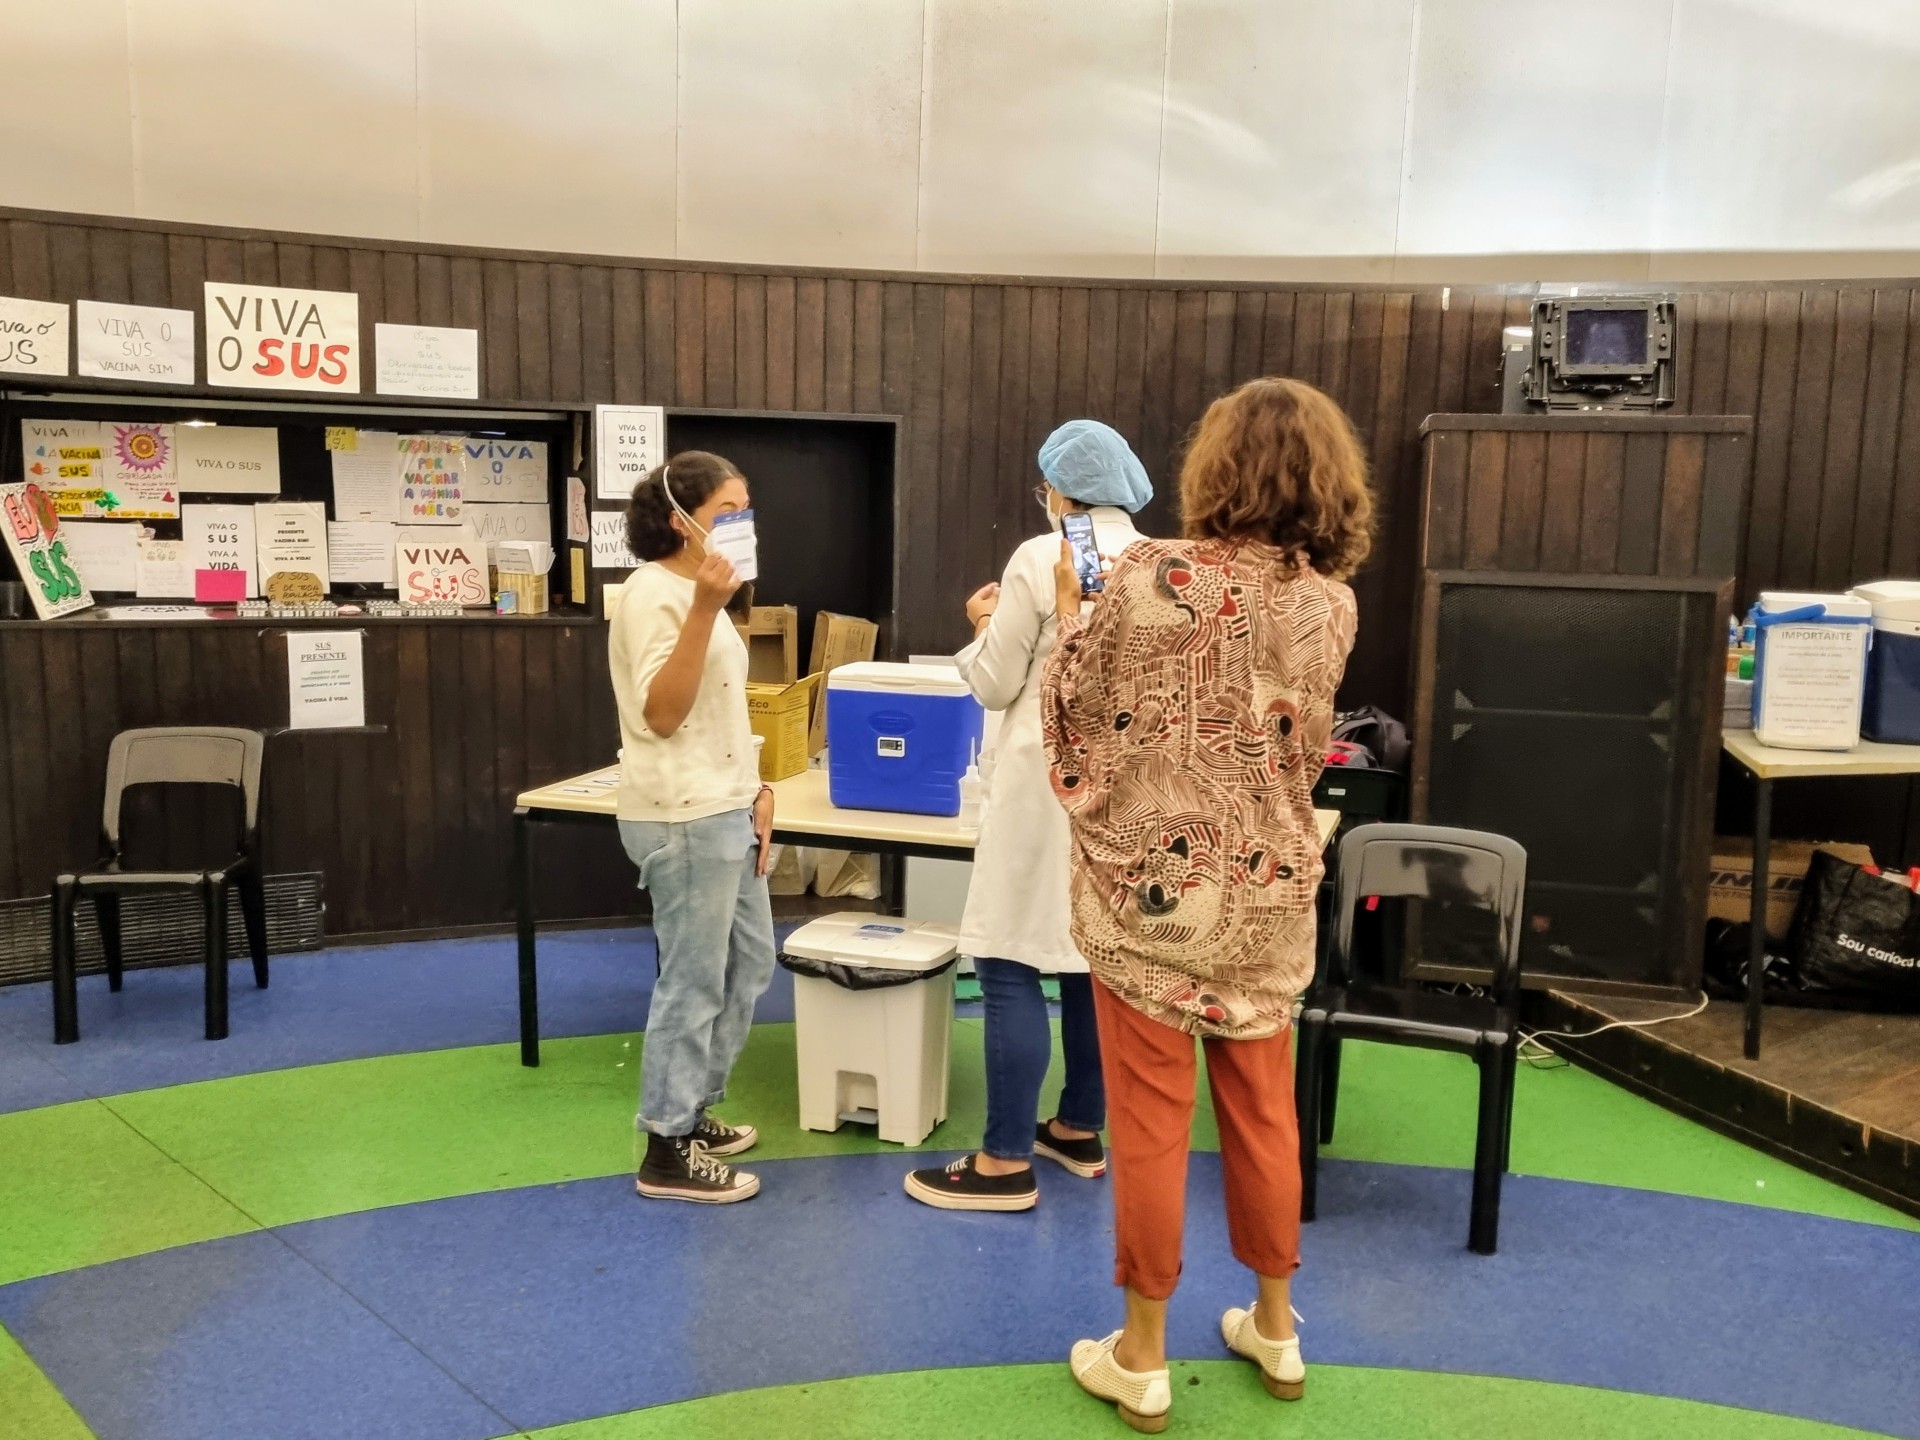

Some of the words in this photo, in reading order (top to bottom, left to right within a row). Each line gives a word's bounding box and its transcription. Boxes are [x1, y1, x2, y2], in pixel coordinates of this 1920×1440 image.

[215, 296, 326, 339] VIVA
[0, 320, 32, 335] va
[98, 318, 144, 340] VIVA
[160, 322, 172, 342] O
[0, 339, 38, 365] US
[122, 342, 152, 357] SUS
[218, 336, 242, 371] O
[252, 338, 350, 384] SUS
[99, 361, 140, 372] VACINA
[149, 364, 173, 374] SIM
[32, 426, 68, 438] VIVA
[59, 449, 100, 459] VACINA
[465, 441, 533, 459] VIVA
[59, 463, 90, 477] SUS
[196, 459, 222, 469] VIVA
[226, 461, 235, 469] O
[239, 462, 261, 471] SUS
[418, 457, 443, 470] POR
[492, 461, 504, 474] O
[619, 463, 647, 472] VIDA
[404, 548, 471, 565] VIVA
[209, 562, 239, 571] VIDA
[407, 568, 486, 605] SUS
[1782, 631, 1852, 641] IMPORTANTE
[315, 642, 332, 650] SUS
[301, 652, 347, 662] PRESENTE
[749, 699, 769, 709] Eco
[1836, 933, 1865, 952] Sou
[1866, 947, 1914, 967] carioca
